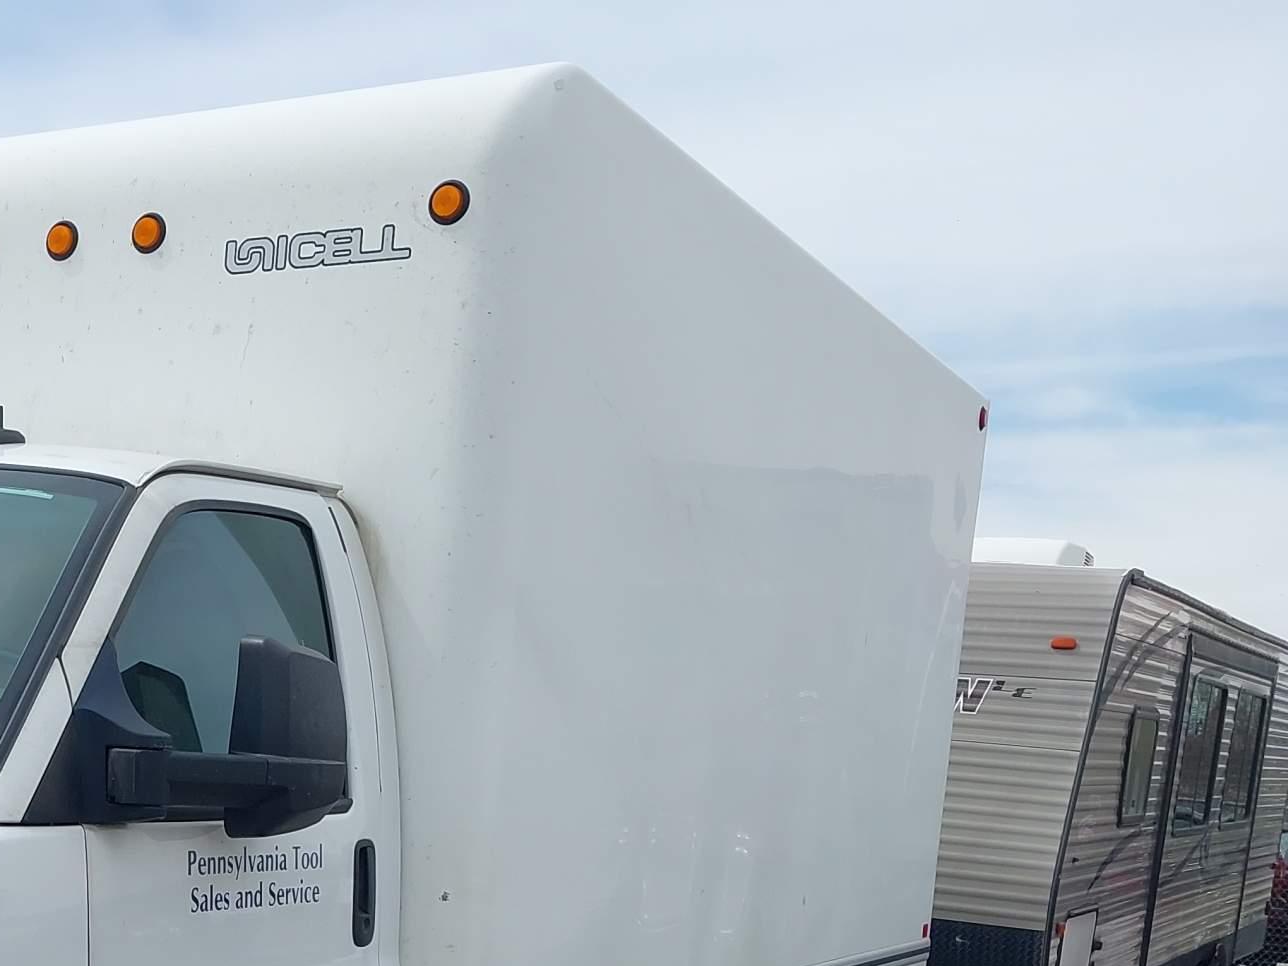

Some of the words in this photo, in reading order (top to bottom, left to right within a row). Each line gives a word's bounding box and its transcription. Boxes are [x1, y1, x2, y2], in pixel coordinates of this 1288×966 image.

[225, 224, 411, 274] UNICELL
[187, 846, 287, 881] Pennsylvania
[292, 843, 324, 870] Tool
[190, 884, 230, 913] Sales
[235, 881, 263, 909] and
[268, 878, 321, 906] Service
